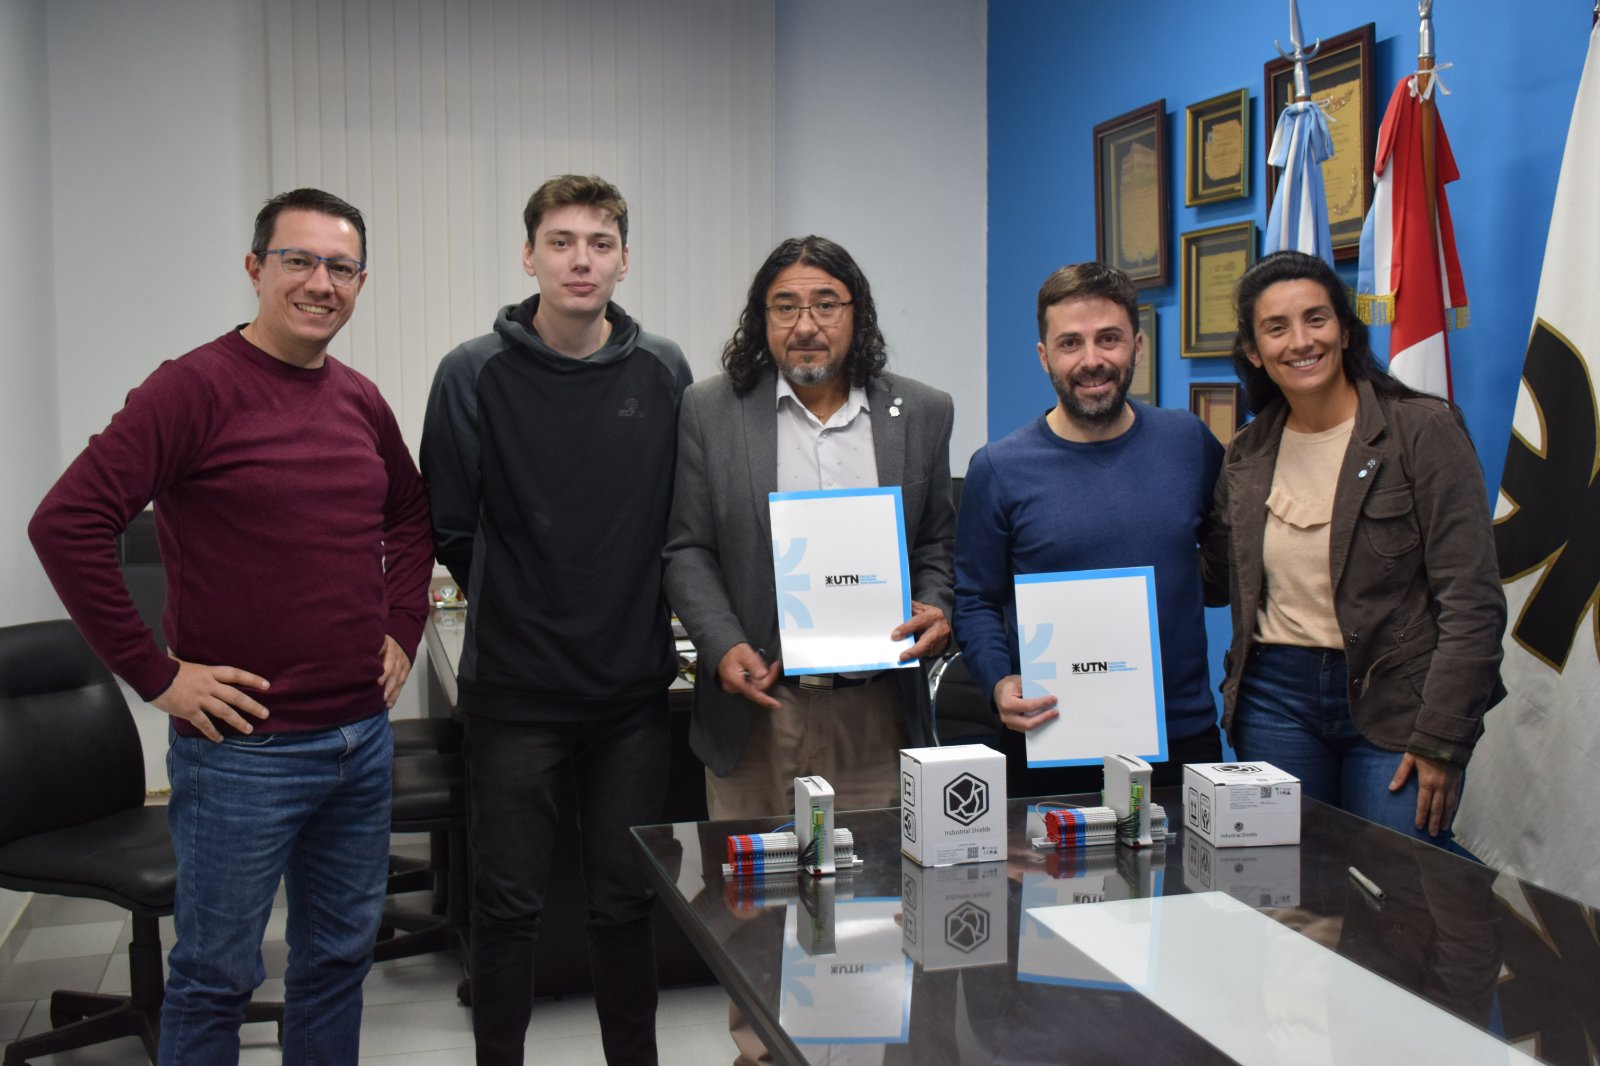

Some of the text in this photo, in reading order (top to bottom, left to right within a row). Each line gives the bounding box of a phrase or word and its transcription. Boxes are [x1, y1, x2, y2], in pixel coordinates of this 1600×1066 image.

[833, 574, 859, 584] UTN
[1081, 661, 1107, 672] UTN
[944, 826, 991, 836] Industrial Shields
